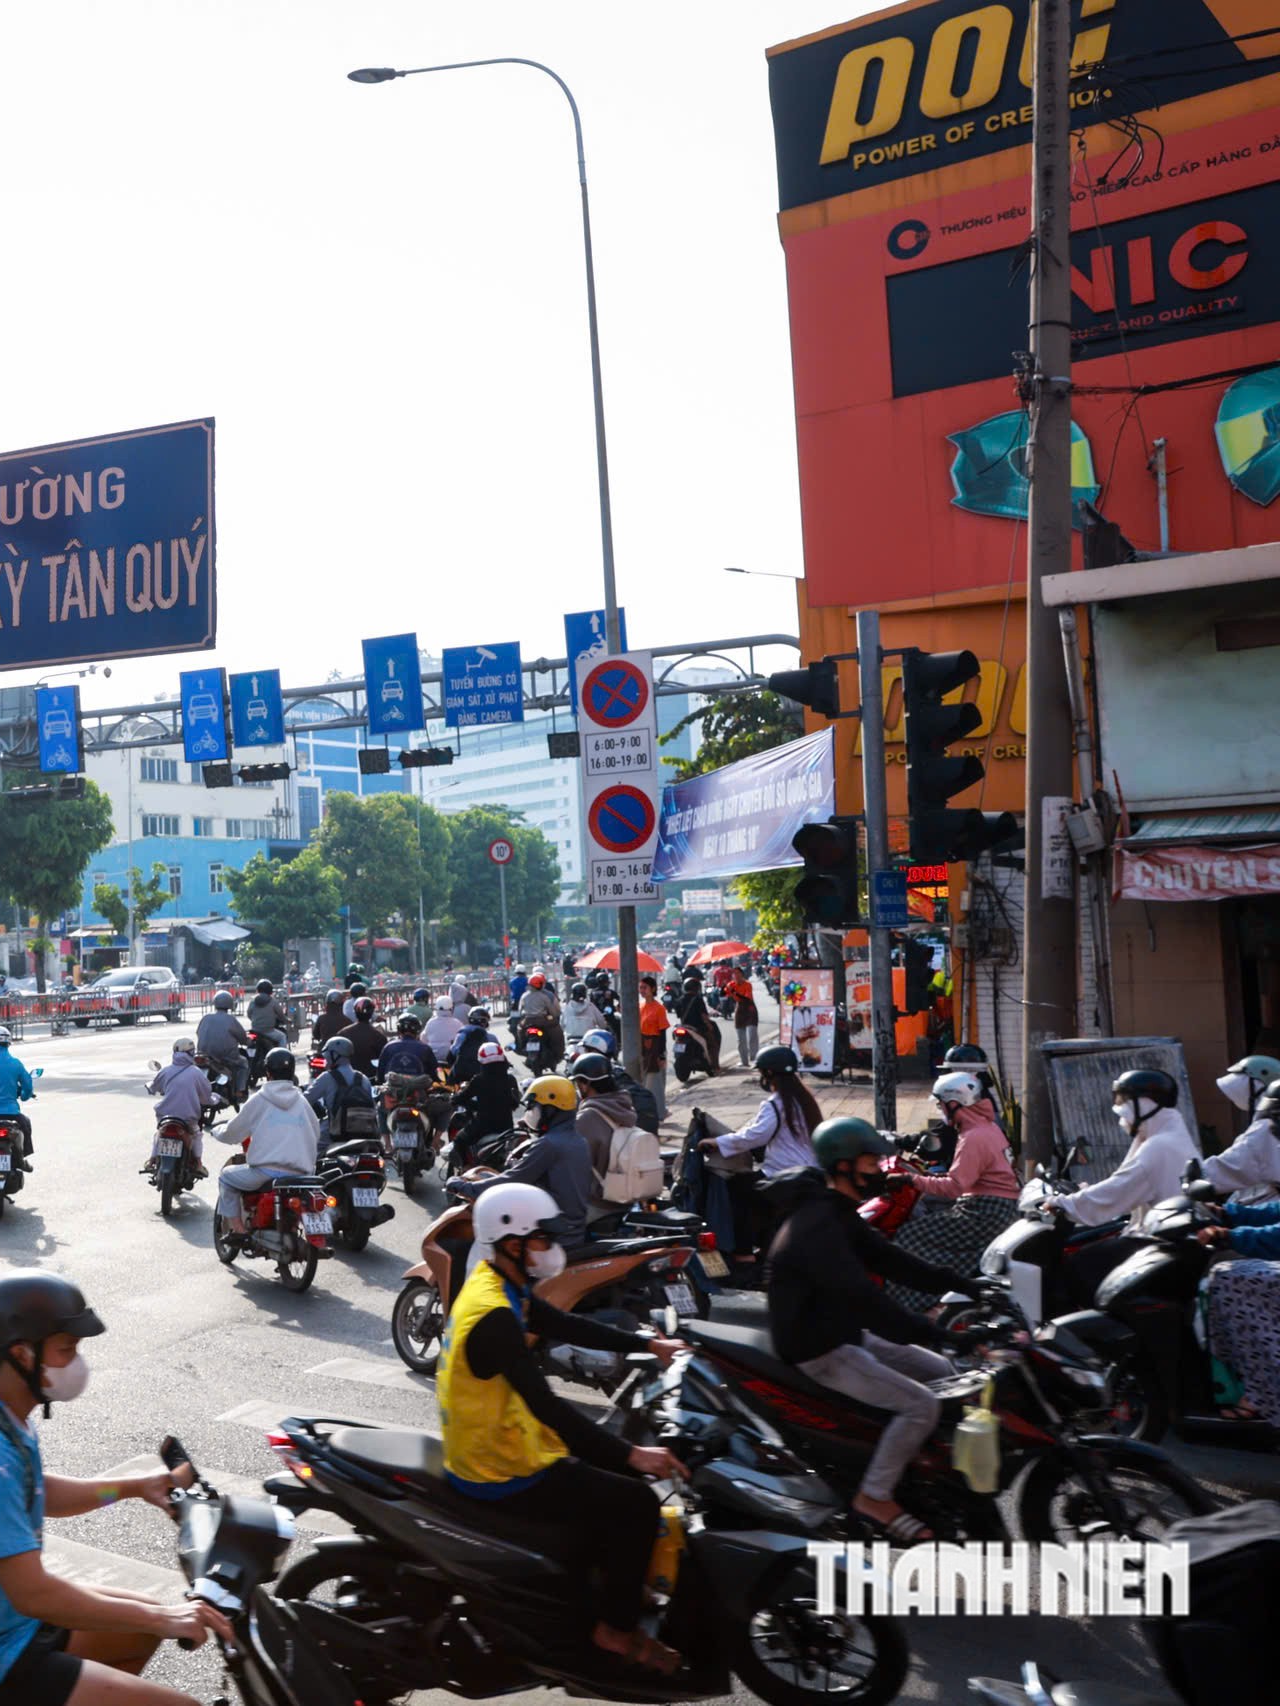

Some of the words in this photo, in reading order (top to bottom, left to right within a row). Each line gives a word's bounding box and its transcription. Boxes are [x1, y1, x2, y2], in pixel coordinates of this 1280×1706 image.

[853, 133, 936, 170] POWER
[945, 123, 976, 143] OF
[940, 215, 993, 235] THƯƠNG
[1131, 172, 1163, 187] CAO
[1167, 157, 1200, 178] CẤP
[1206, 148, 1251, 168] HÀNG
[1119, 314, 1154, 331] AND
[1158, 296, 1238, 322] QUALITY
[41, 537, 115, 623] TÂN
[125, 516, 207, 614] QUÝ
[481, 710, 512, 724] CAMERA
[1134, 857, 1258, 891] CHUYÊN
